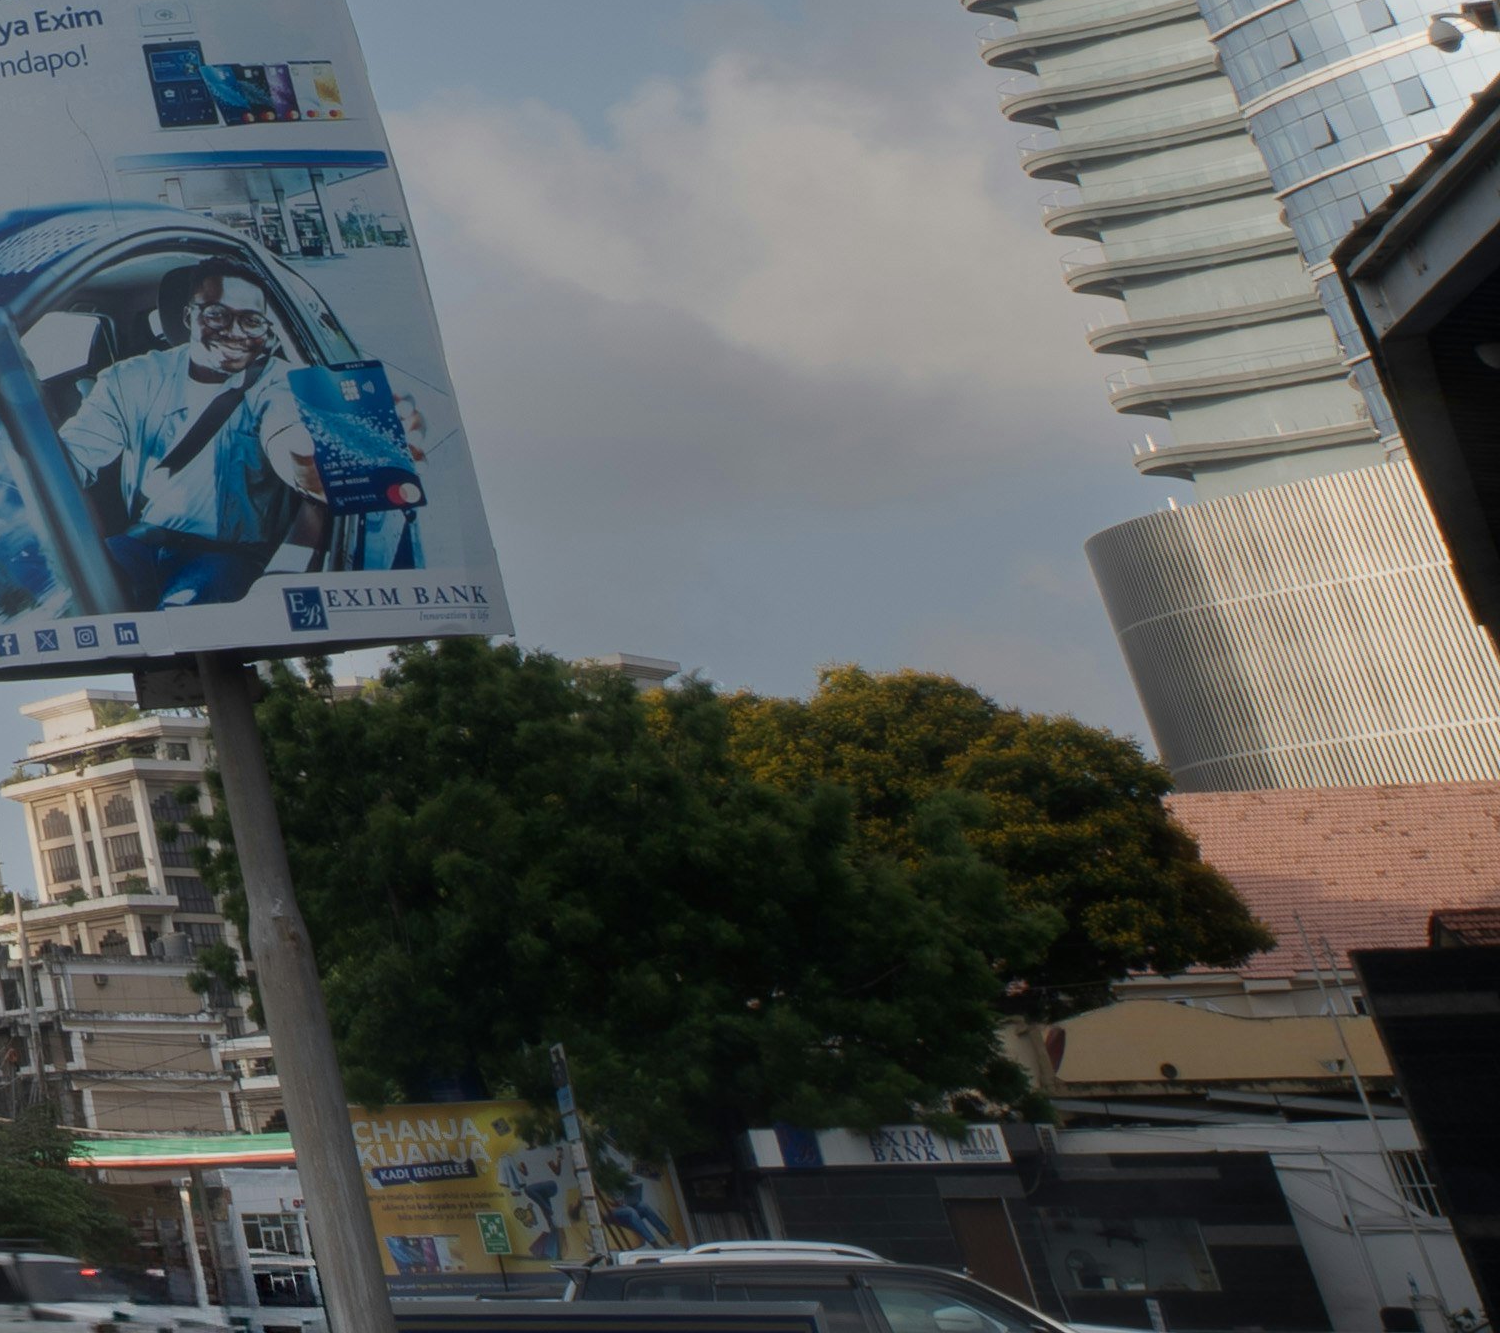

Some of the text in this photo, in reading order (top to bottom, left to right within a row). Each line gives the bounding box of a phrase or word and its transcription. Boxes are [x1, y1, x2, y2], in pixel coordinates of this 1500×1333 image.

[34, 6, 104, 35] Exim
[324, 585, 489, 607] EXIM BANK
[419, 610, 468, 622] Innovation
[356, 1140, 491, 1166] KIJANJA
[872, 1145, 941, 1162] BANK
